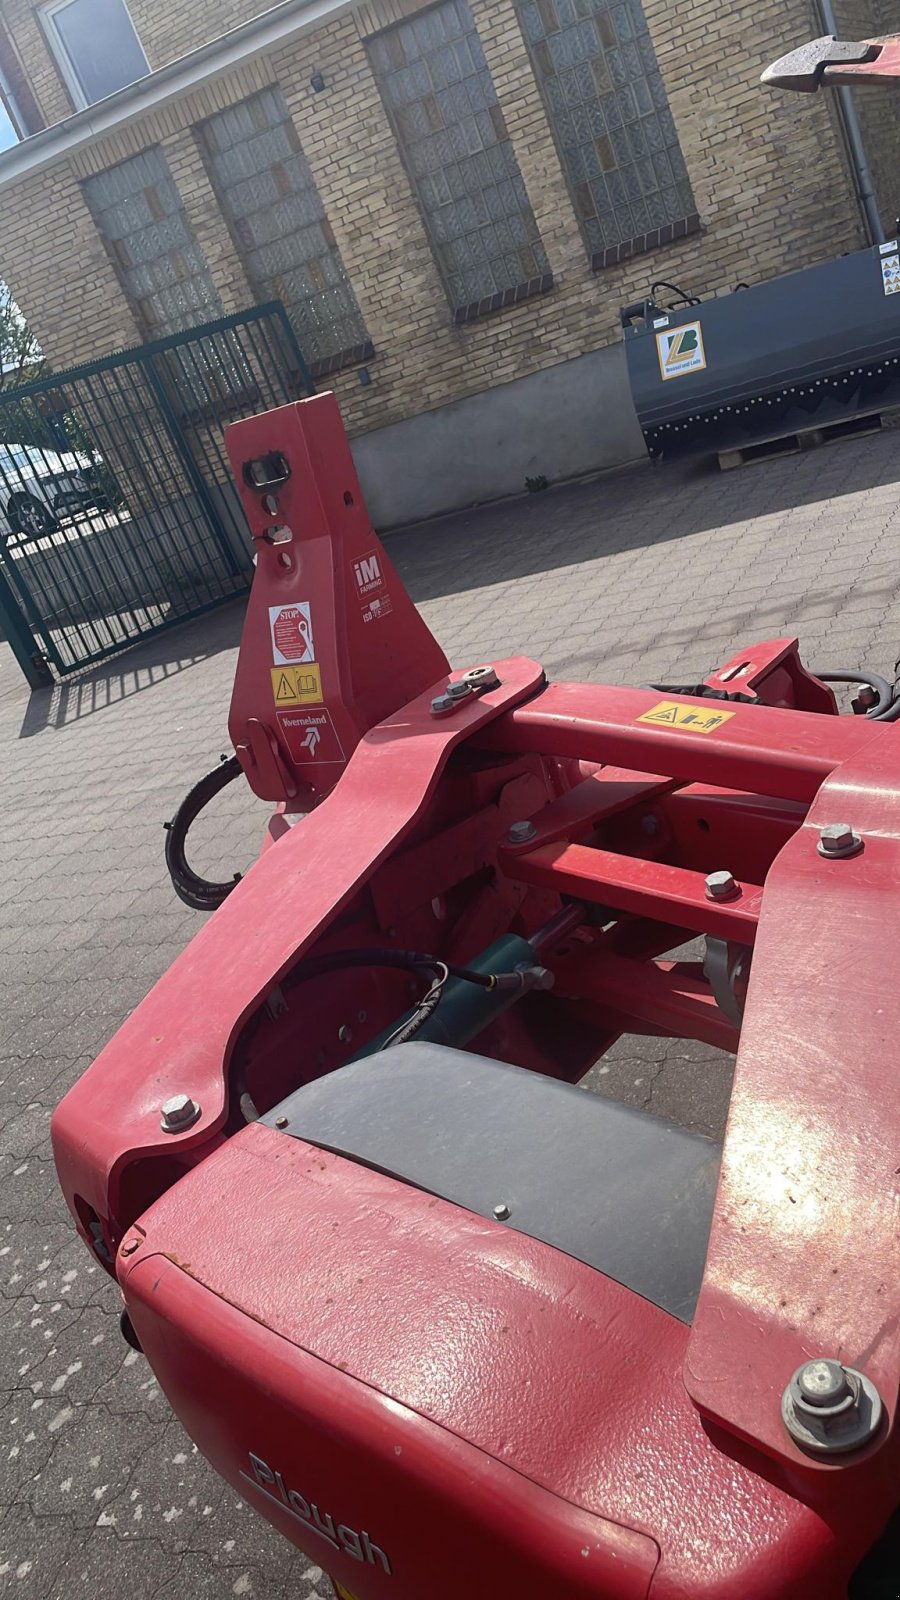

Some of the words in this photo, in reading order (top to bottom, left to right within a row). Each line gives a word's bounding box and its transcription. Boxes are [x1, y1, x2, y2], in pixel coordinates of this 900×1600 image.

[353, 555, 381, 587] iM
[360, 578, 382, 594] FARMING
[282, 714, 327, 727] Kverneland
[249, 1451, 392, 1575] Plough
